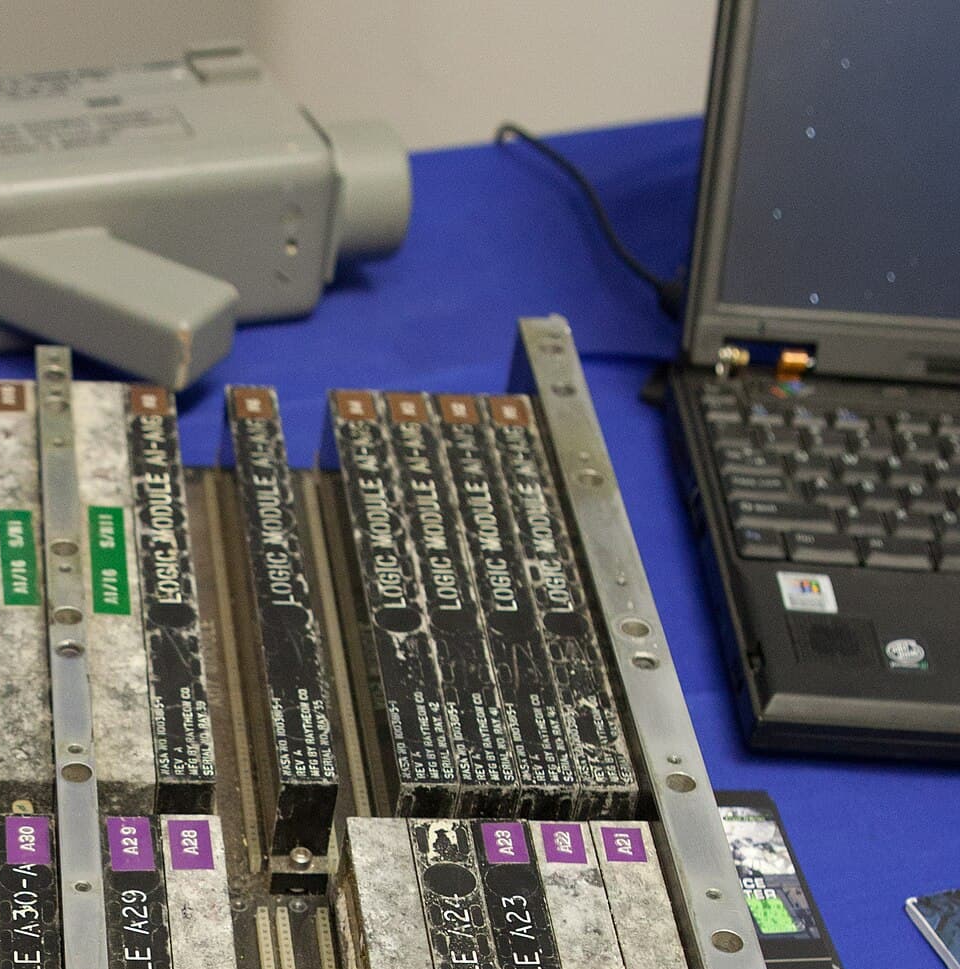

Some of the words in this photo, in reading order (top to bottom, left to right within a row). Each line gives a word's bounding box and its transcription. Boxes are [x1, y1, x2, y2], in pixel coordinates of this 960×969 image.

[145, 472, 177, 548] MODULE
[254, 475, 287, 547] MODULE
[357, 477, 392, 549] MODULE
[412, 479, 445, 551] MODULE
[464, 479, 498, 552] MODULE
[518, 482, 553, 554] MODULE
[155, 550, 182, 603] LOGIC
[267, 551, 294, 605] LOGIC
[373, 554, 407, 609] LOGIC
[429, 555, 463, 611] LOGIC
[484, 558, 518, 613] LOGIC
[543, 559, 574, 614] LOGIC
[18, 826, 37, 851] A30
[119, 825, 140, 855] A29
[181, 830, 200, 855] A28
[494, 829, 515, 856] A23
[614, 832, 634, 855] A21
[120, 889, 150, 935] A29
[442, 893, 472, 938] A24
[501, 894, 536, 940] A23
